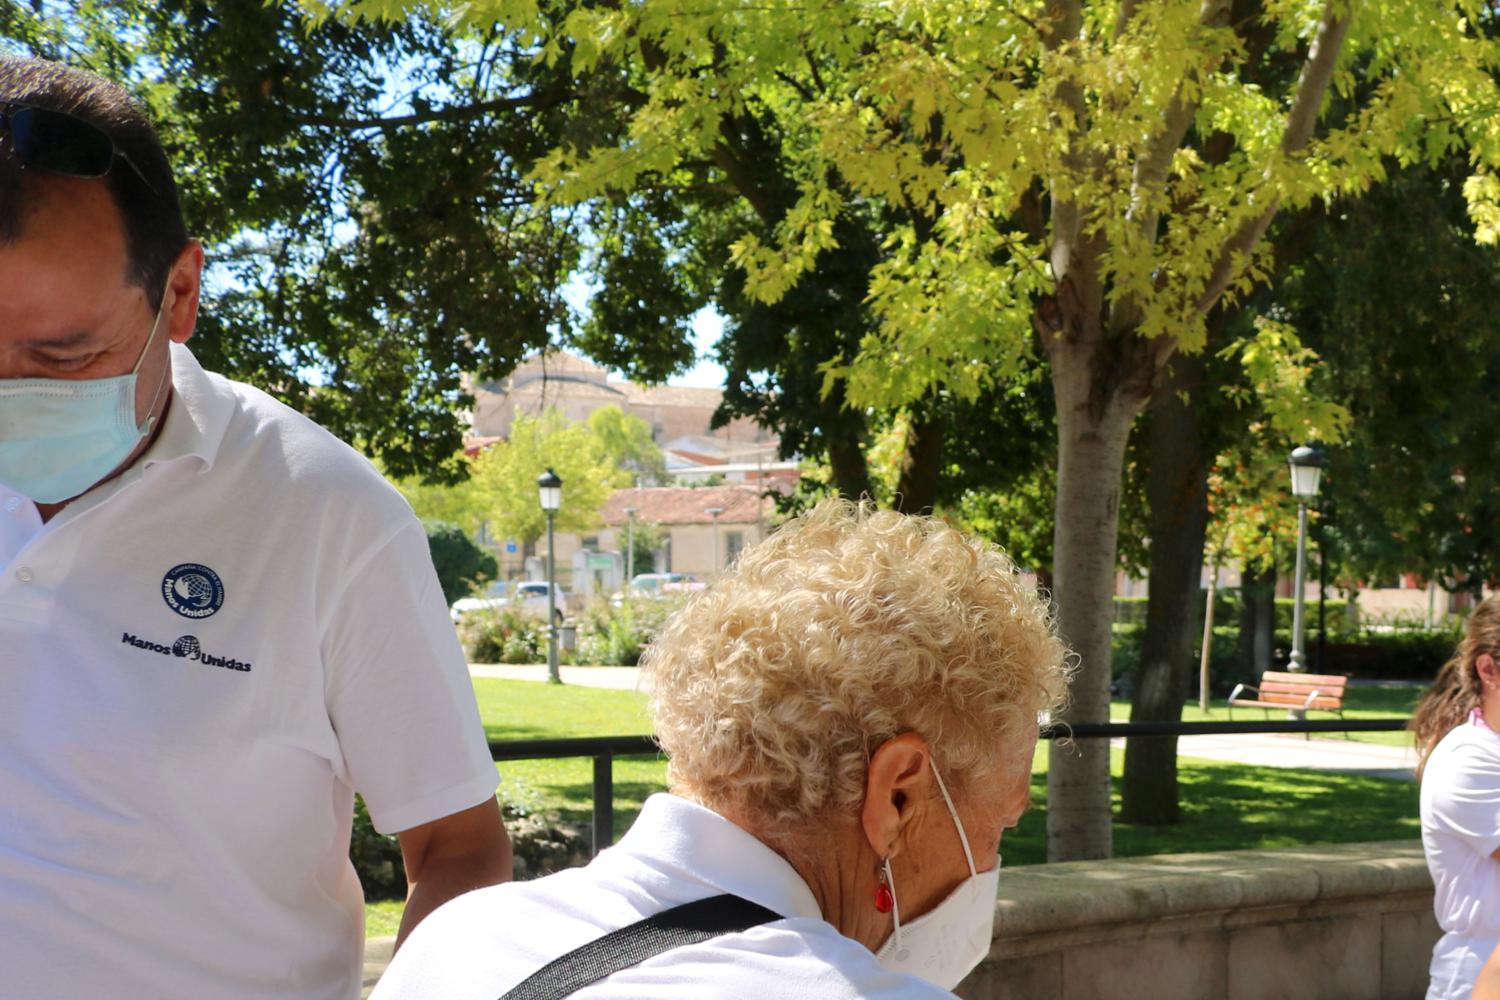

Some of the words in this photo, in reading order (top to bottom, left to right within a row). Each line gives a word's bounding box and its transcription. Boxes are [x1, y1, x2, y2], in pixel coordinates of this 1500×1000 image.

[164, 578, 179, 608] Manos
[179, 605, 215, 617] Unidas
[121, 632, 171, 655] Manos
[201, 653, 252, 672] Unidas
